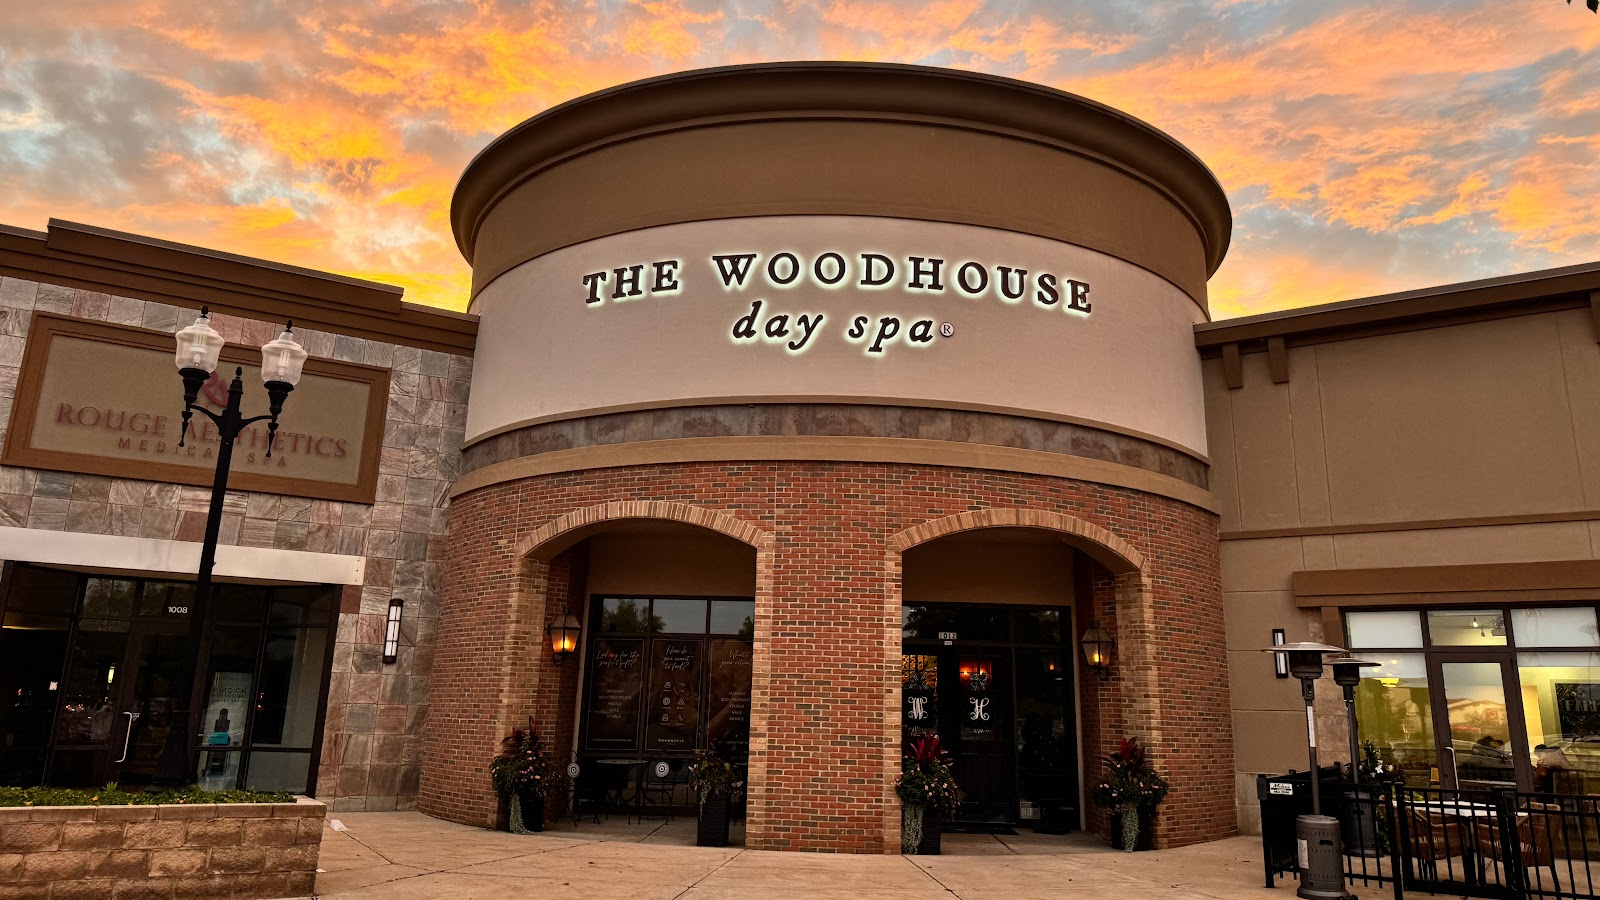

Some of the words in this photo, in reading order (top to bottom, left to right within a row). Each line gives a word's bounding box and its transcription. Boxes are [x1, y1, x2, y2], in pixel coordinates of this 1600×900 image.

[582, 260, 679, 304] THE
[711, 252, 1092, 314] WOODHOUSE
[732, 300, 824, 351] day
[57, 402, 168, 436] ROUGE
[185, 419, 347, 458] AETHETICS
[118, 437, 213, 458] MEDICA
[167, 605, 188, 614] 1008
